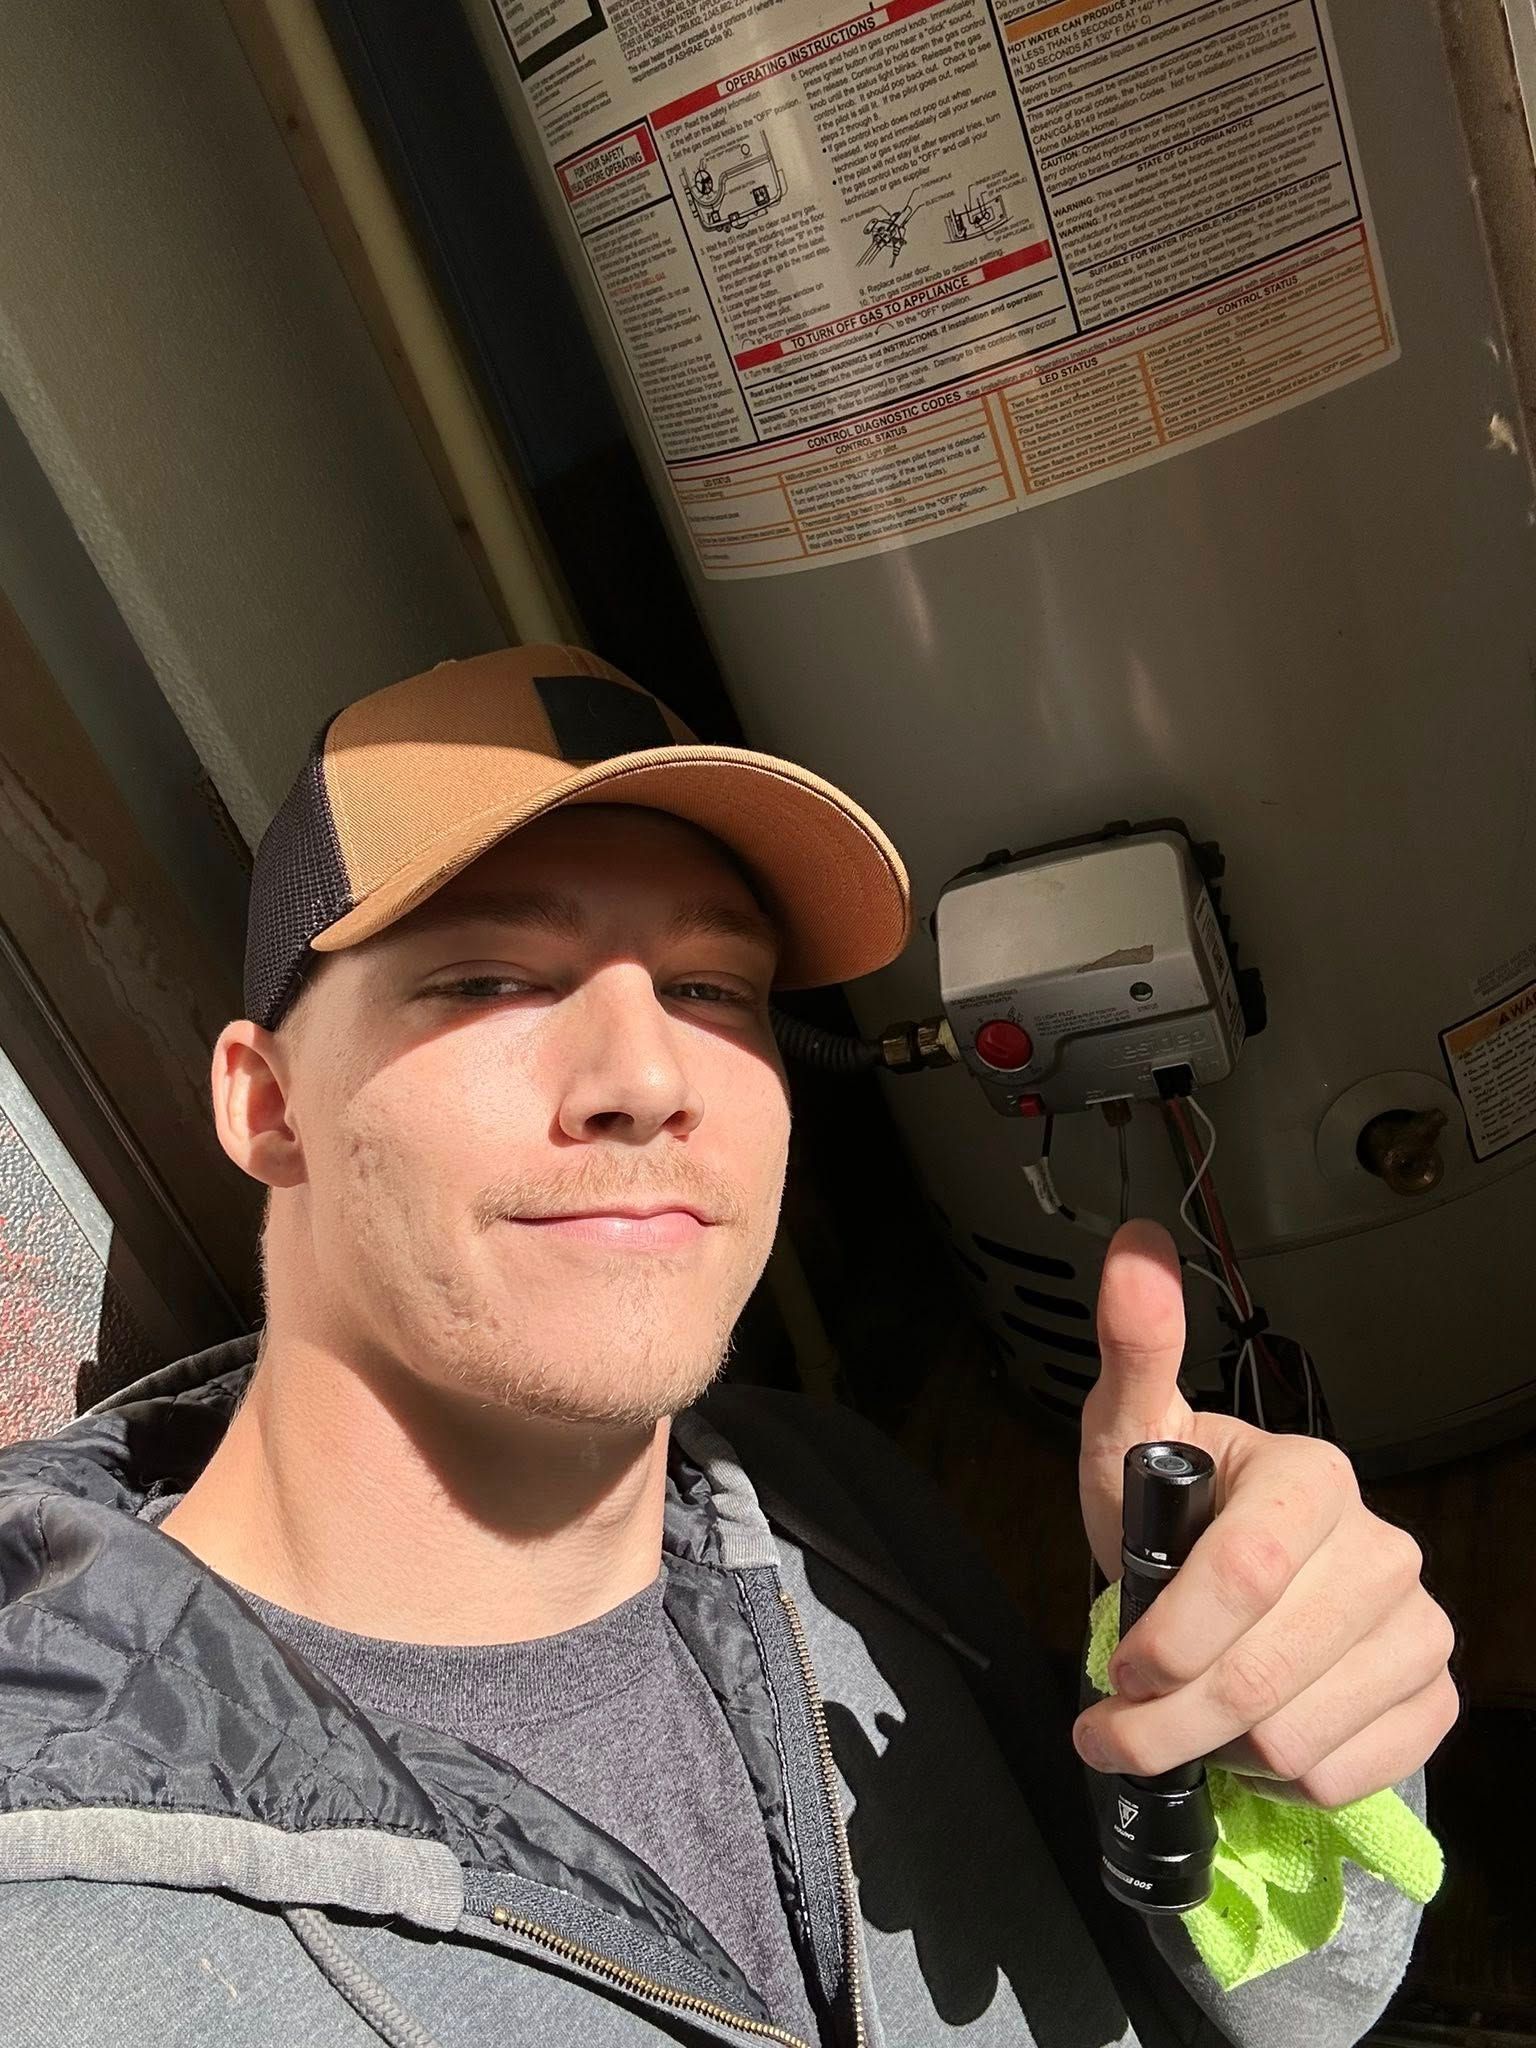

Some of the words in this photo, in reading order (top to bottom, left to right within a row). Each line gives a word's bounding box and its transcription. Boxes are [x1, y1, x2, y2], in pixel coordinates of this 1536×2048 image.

[1007, 39, 1026, 55] HOT
[1027, 26, 1060, 46] WATER
[1061, 17, 1082, 32] CAN
[1082, 0, 1127, 24] PRODUCE
[674, 41, 704, 63] ASHRAE
[725, 56, 791, 92] OPERATING
[787, 16, 876, 65] INSTRUCTIONS
[573, 165, 586, 179] FOR
[583, 157, 602, 173] YOUR
[599, 144, 625, 166] SAFETY
[1136, 155, 1163, 172] STATE
[1163, 150, 1175, 161] OF
[1176, 130, 1225, 155] CALIFORNIA
[1225, 118, 1255, 135] NOTICE
[582, 168, 606, 188] BEFORE
[604, 150, 643, 177] OPERATING
[790, 336, 805, 349] TO
[805, 325, 835, 343] TURN
[835, 317, 857, 333] OFF
[858, 307, 883, 324] GAS
[883, 301, 901, 315] TO
[903, 274, 970, 309] APPLIANCE
[1216, 291, 1263, 315] CONTROL
[1263, 275, 1298, 296] STATUS
[1038, 371, 1059, 385] LED
[1060, 356, 1098, 377] STATUS
[806, 428, 854, 448] CONTROL
[853, 405, 919, 434] DIAGNOSTIC
[920, 390, 961, 412] CODES
[834, 437, 874, 455] CONTROL
[874, 425, 907, 442] STATUS
[1133, 1879, 1154, 1891] 500
